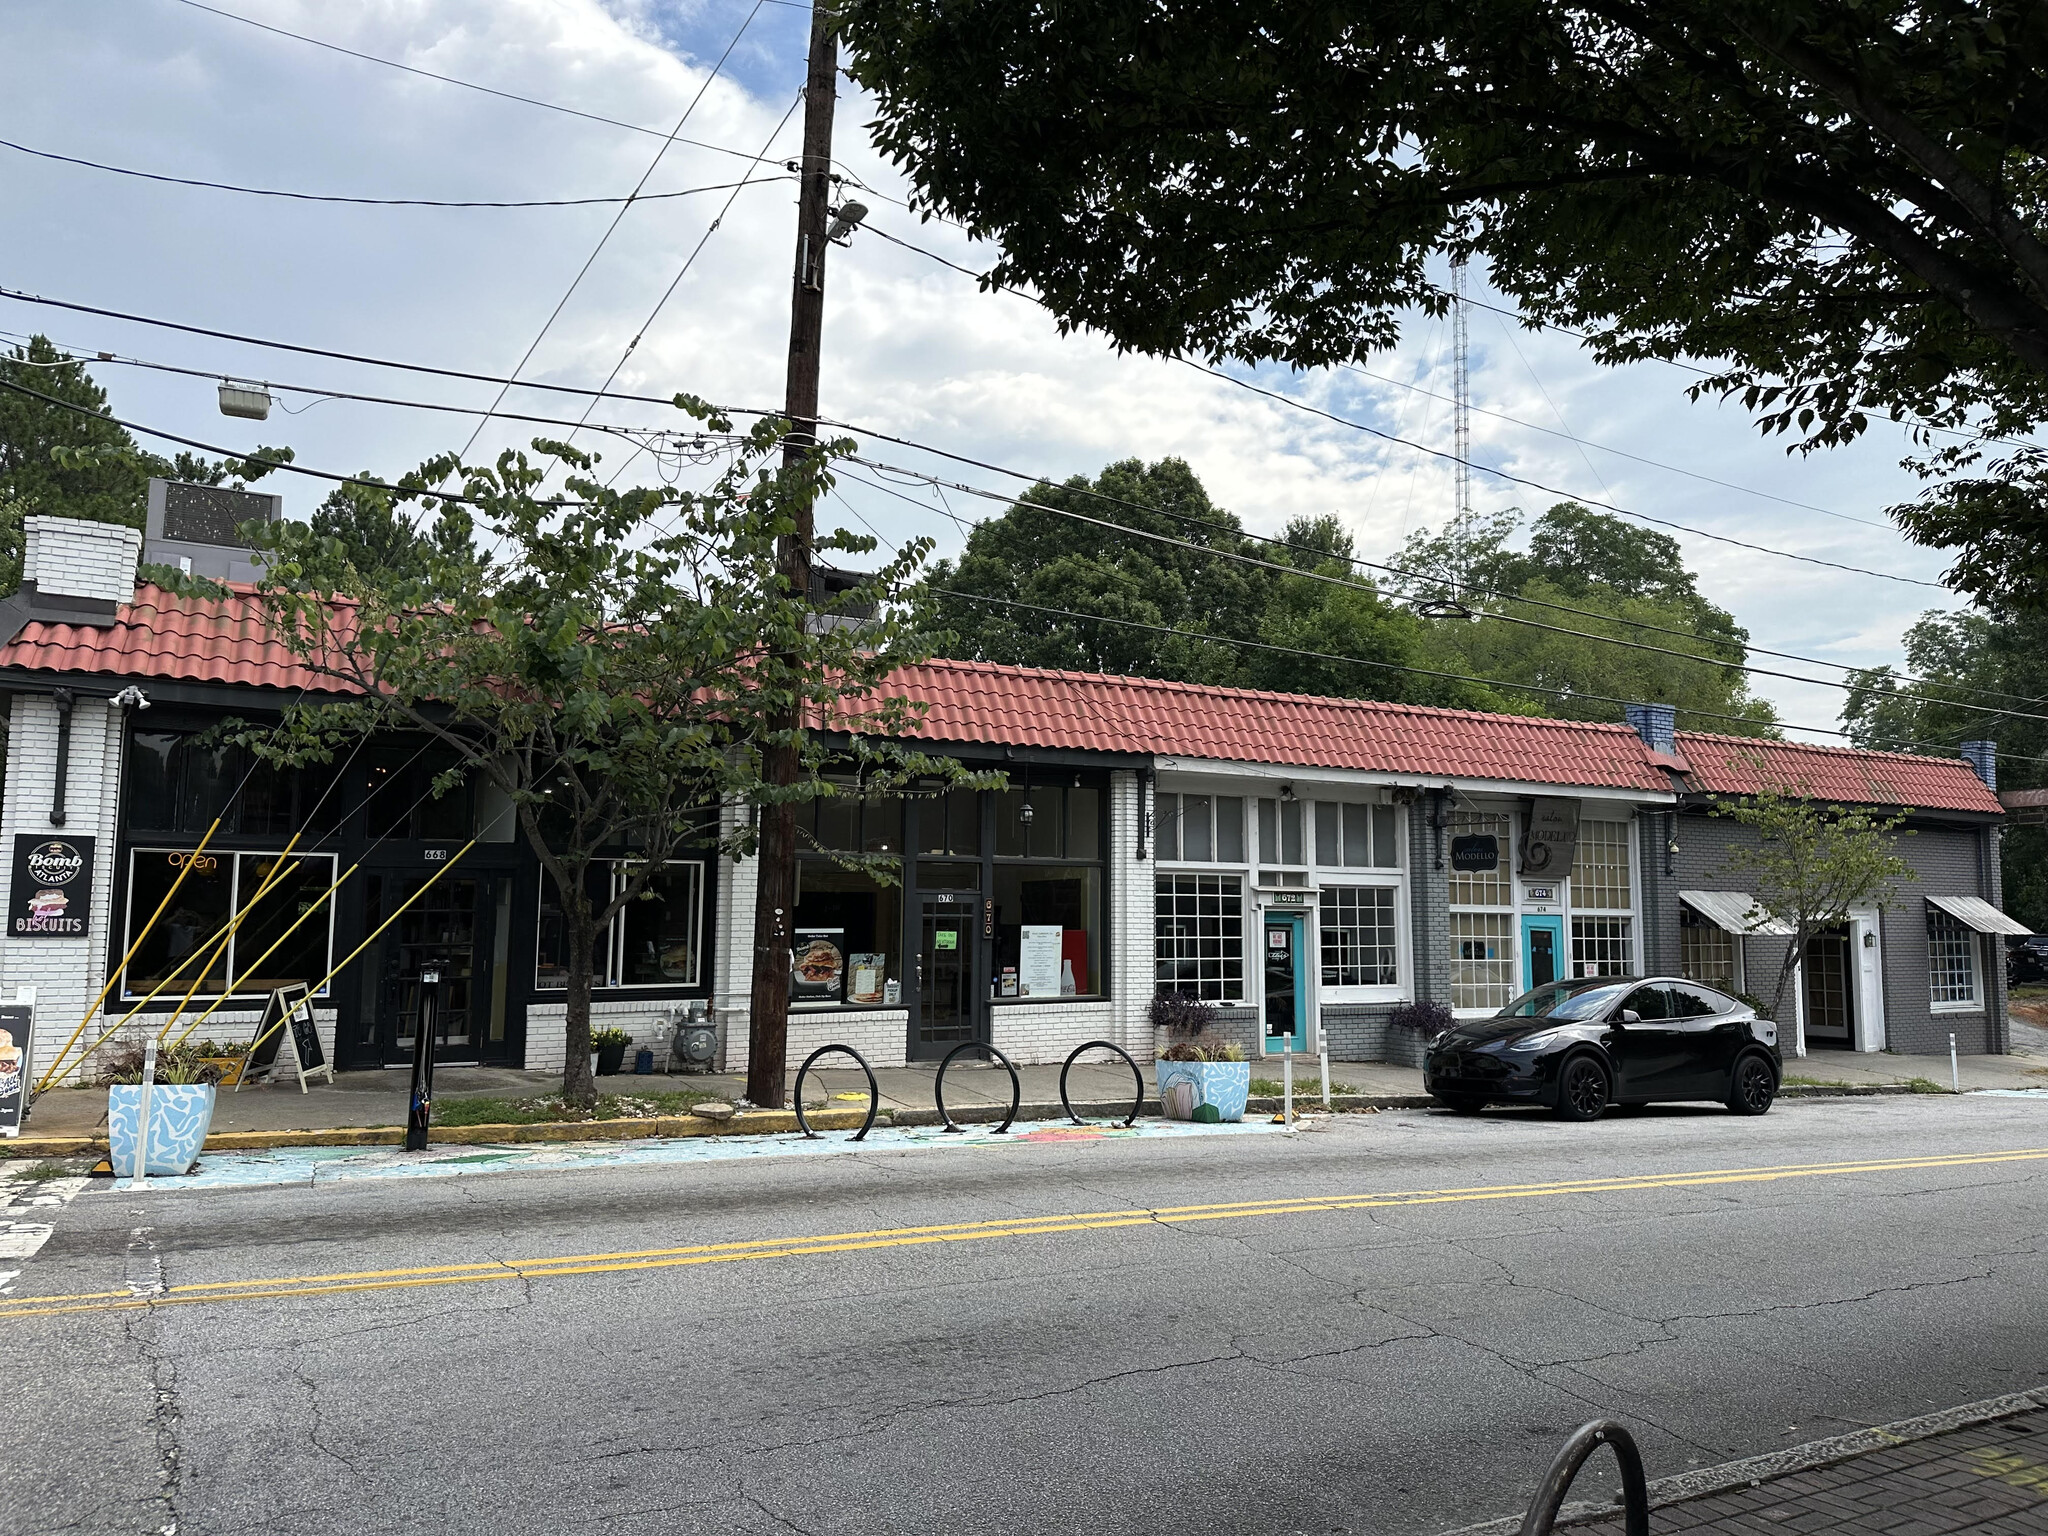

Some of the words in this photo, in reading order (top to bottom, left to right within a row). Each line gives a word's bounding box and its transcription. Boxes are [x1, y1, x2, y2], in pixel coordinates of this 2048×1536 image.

[425, 850, 446, 859] 668
[1456, 851, 1495, 861] MODELLO
[28, 853, 83, 867] Bomb
[34, 869, 74, 883] ATLANTA
[1281, 893, 1296, 902] 672
[1534, 889, 1547, 897] 674
[938, 894, 953, 902] 670
[16, 917, 82, 932] BISCUITS
